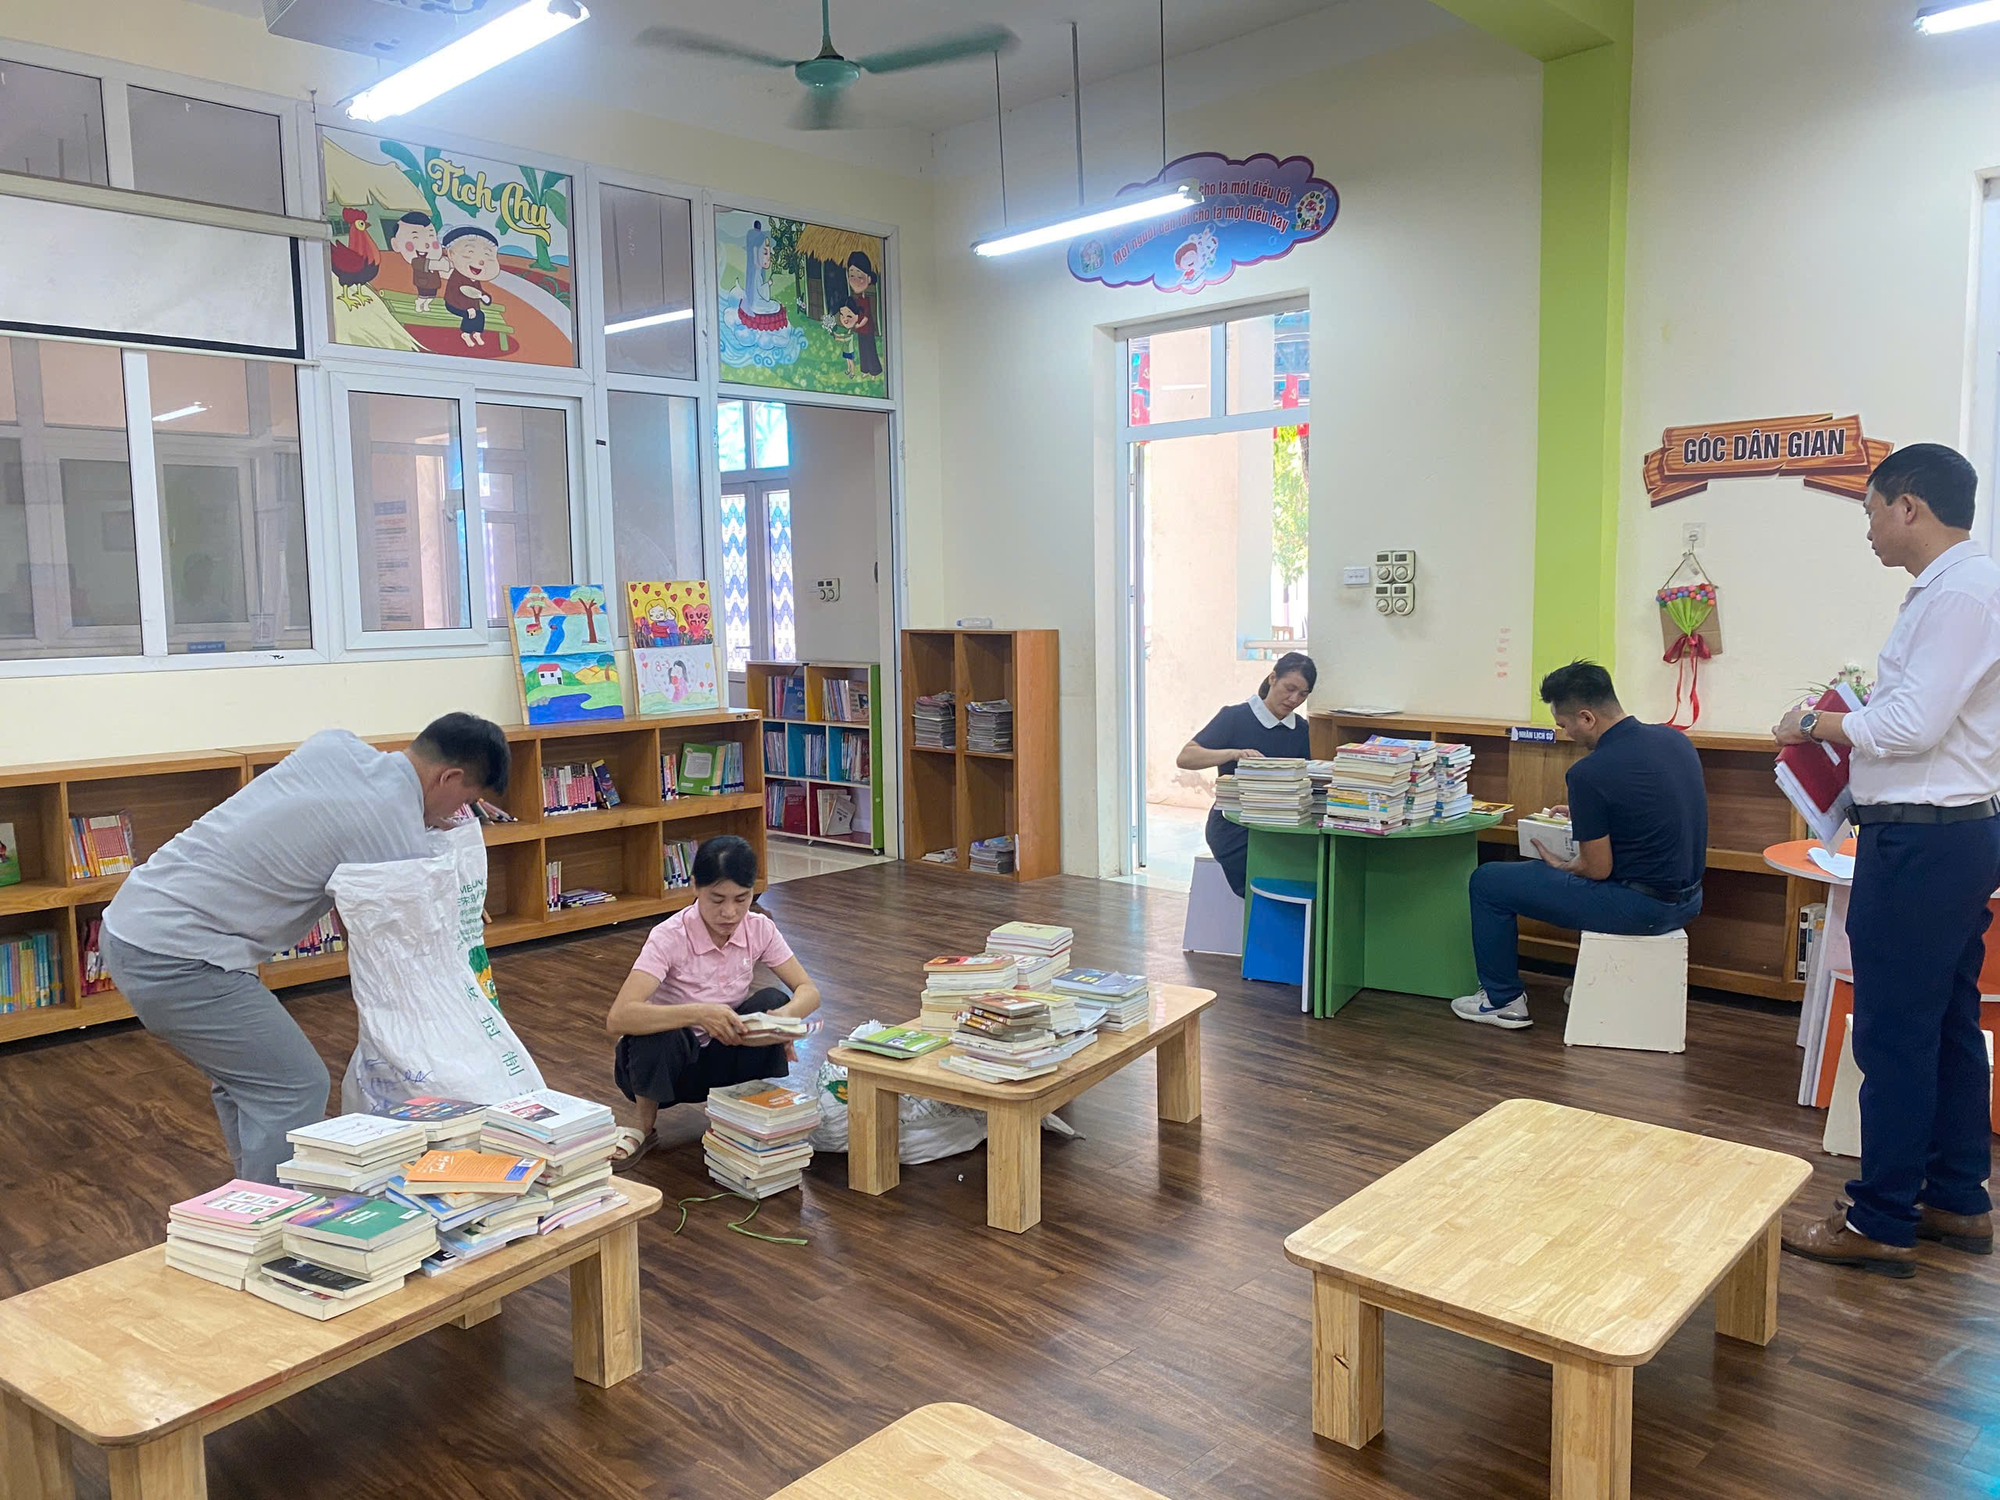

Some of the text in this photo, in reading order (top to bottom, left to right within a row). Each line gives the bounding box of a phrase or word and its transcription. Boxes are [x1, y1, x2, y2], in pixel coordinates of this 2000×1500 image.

[1219, 181, 1228, 194] ta
[1230, 179, 1250, 197] một
[500, 182, 551, 246] Chu
[1192, 208, 1210, 222] cho
[1213, 206, 1222, 219] ta
[1225, 204, 1244, 221] một
[1269, 211, 1289, 233] hay
[1683, 428, 1846, 464] GÓC DÂN GIAN
